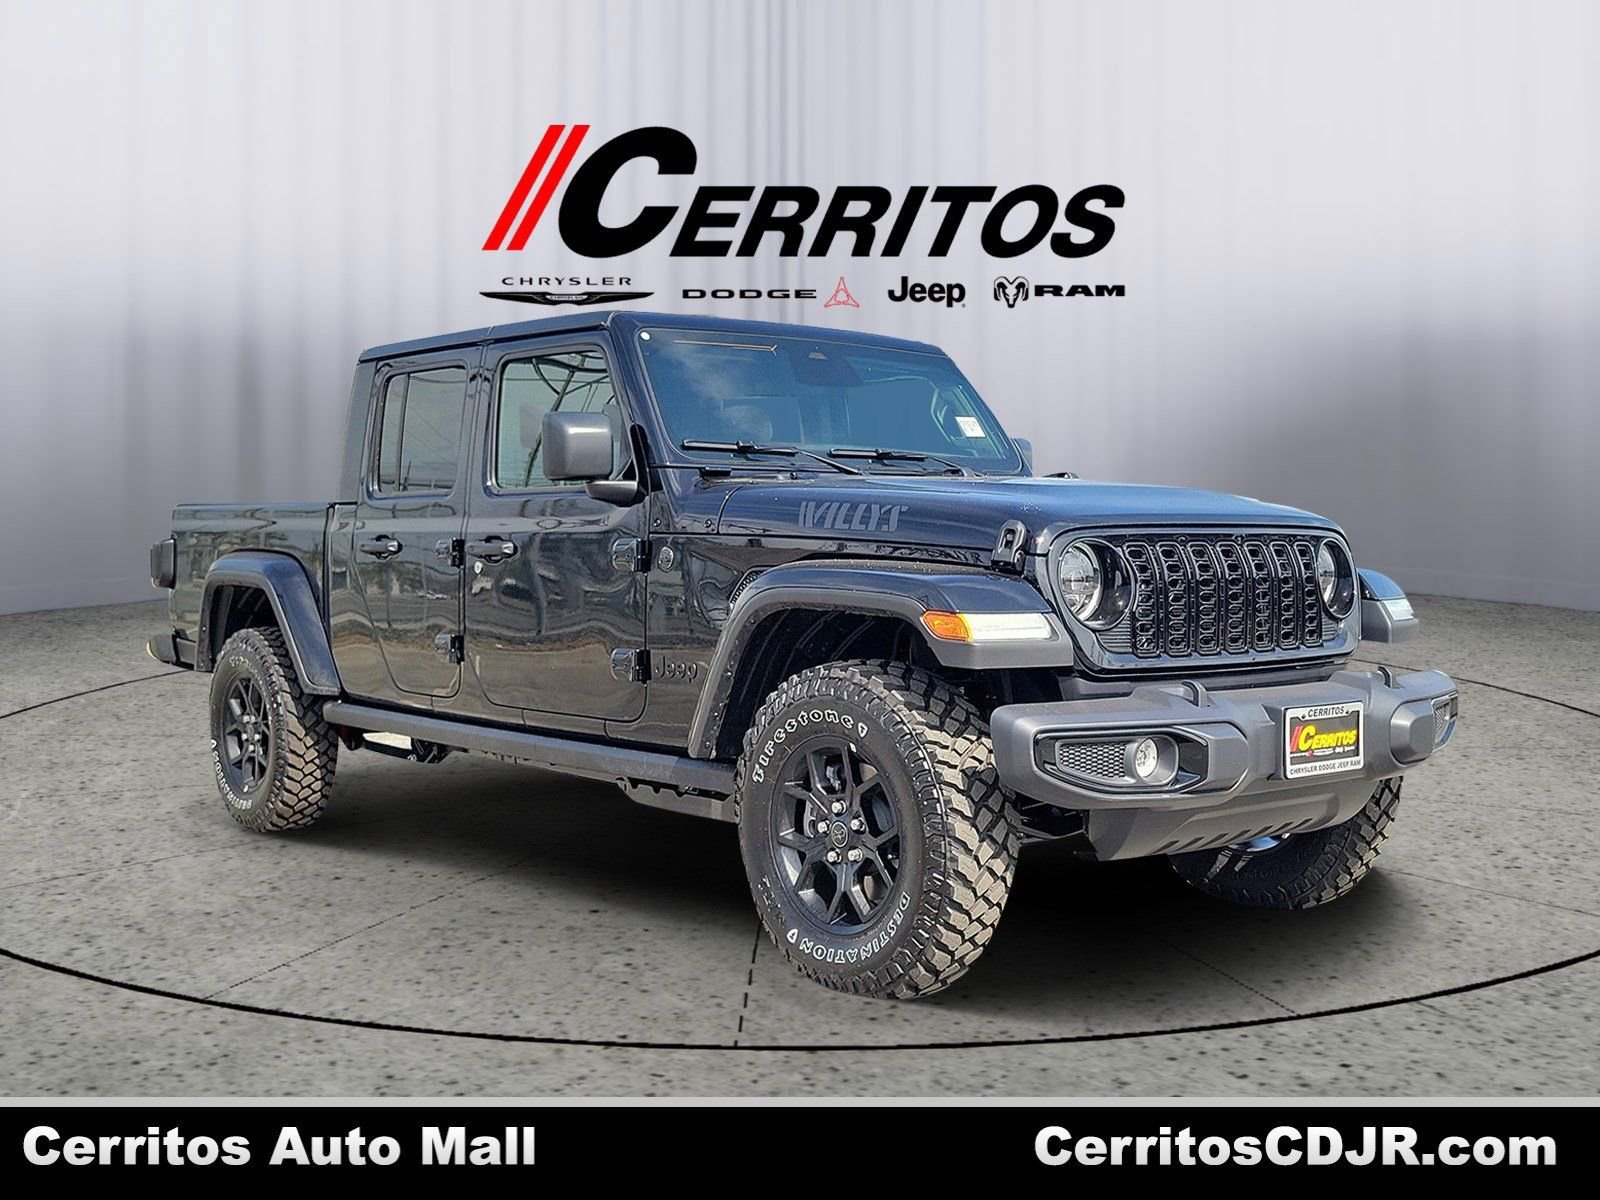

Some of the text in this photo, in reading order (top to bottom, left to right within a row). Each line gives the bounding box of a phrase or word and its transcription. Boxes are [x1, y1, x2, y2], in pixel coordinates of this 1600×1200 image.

[799, 501, 908, 532] WILLYS
[654, 656, 698, 682] Jeep
[1307, 706, 1345, 718] CERRITOS
[1298, 725, 1357, 752] CERRITOS
[1289, 759, 1361, 775] CHRYSLER DODGE JEEP RAM
[799, 891, 911, 964] DESTINATION
